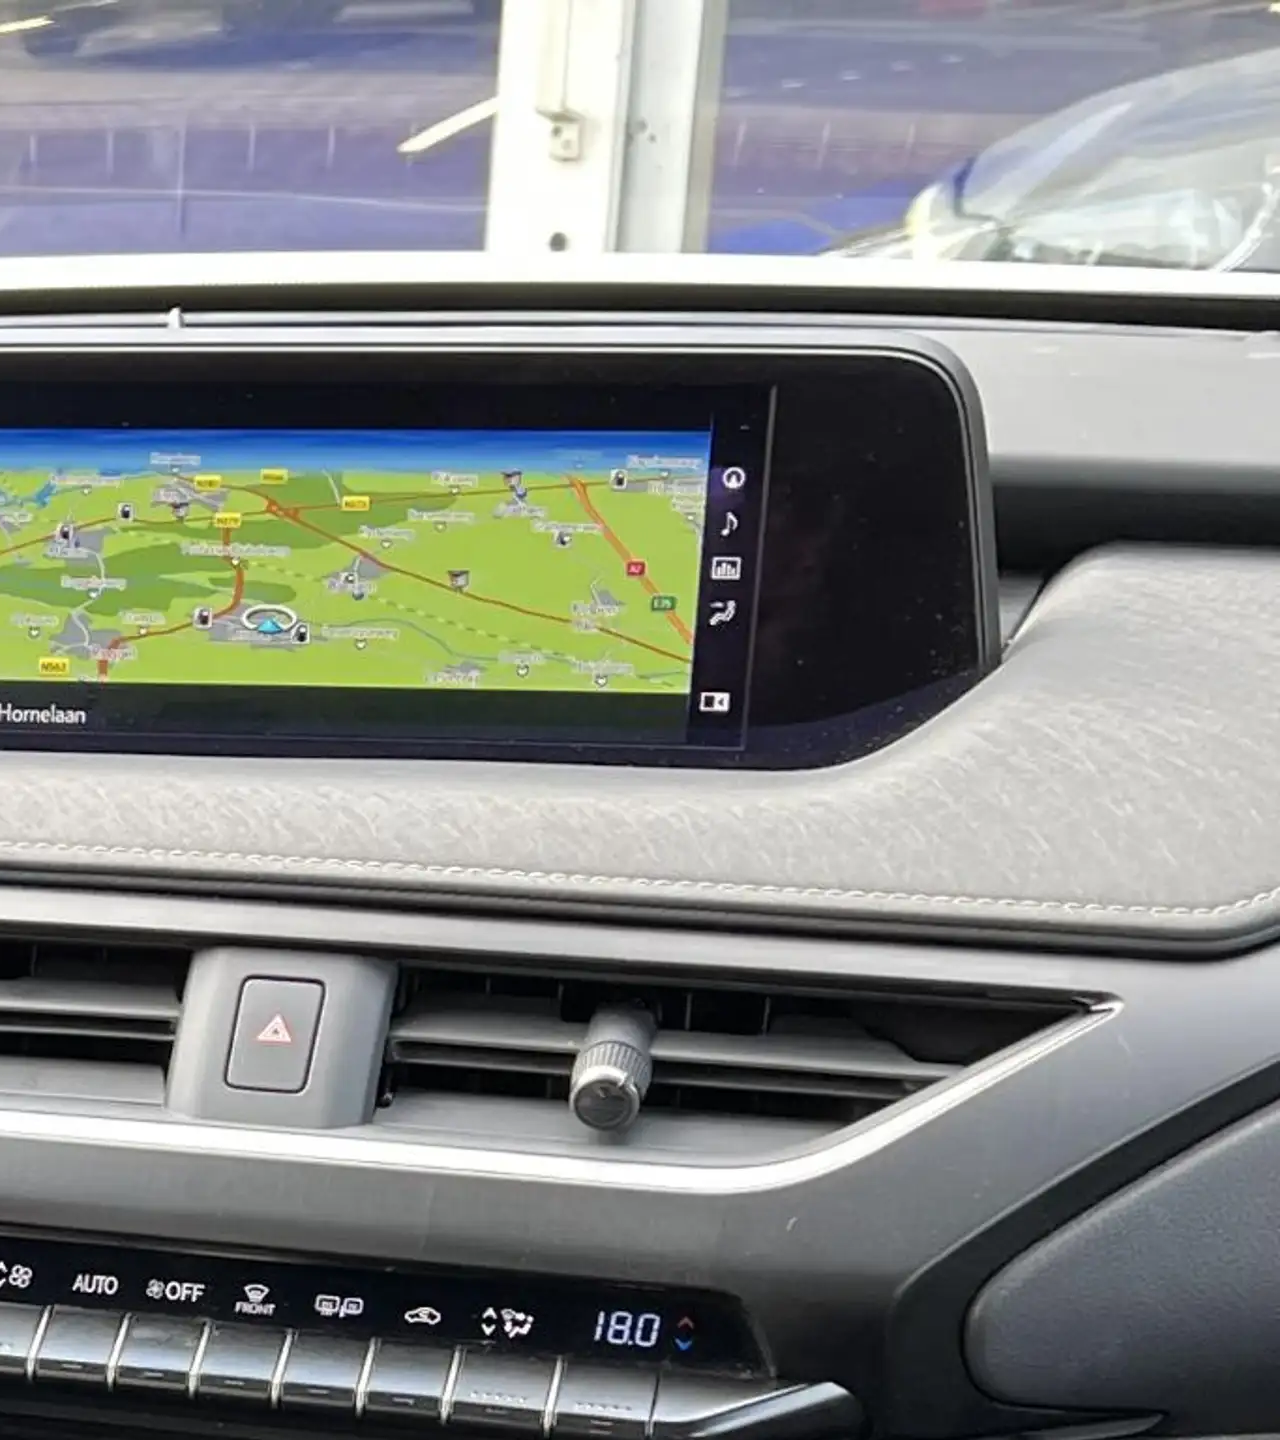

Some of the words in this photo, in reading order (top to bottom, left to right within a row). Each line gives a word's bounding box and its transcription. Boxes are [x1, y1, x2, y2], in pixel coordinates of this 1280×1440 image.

[72, 1273, 120, 1296] AUTO
[164, 1280, 206, 1303] OFF
[234, 1301, 277, 1317] FRONT
